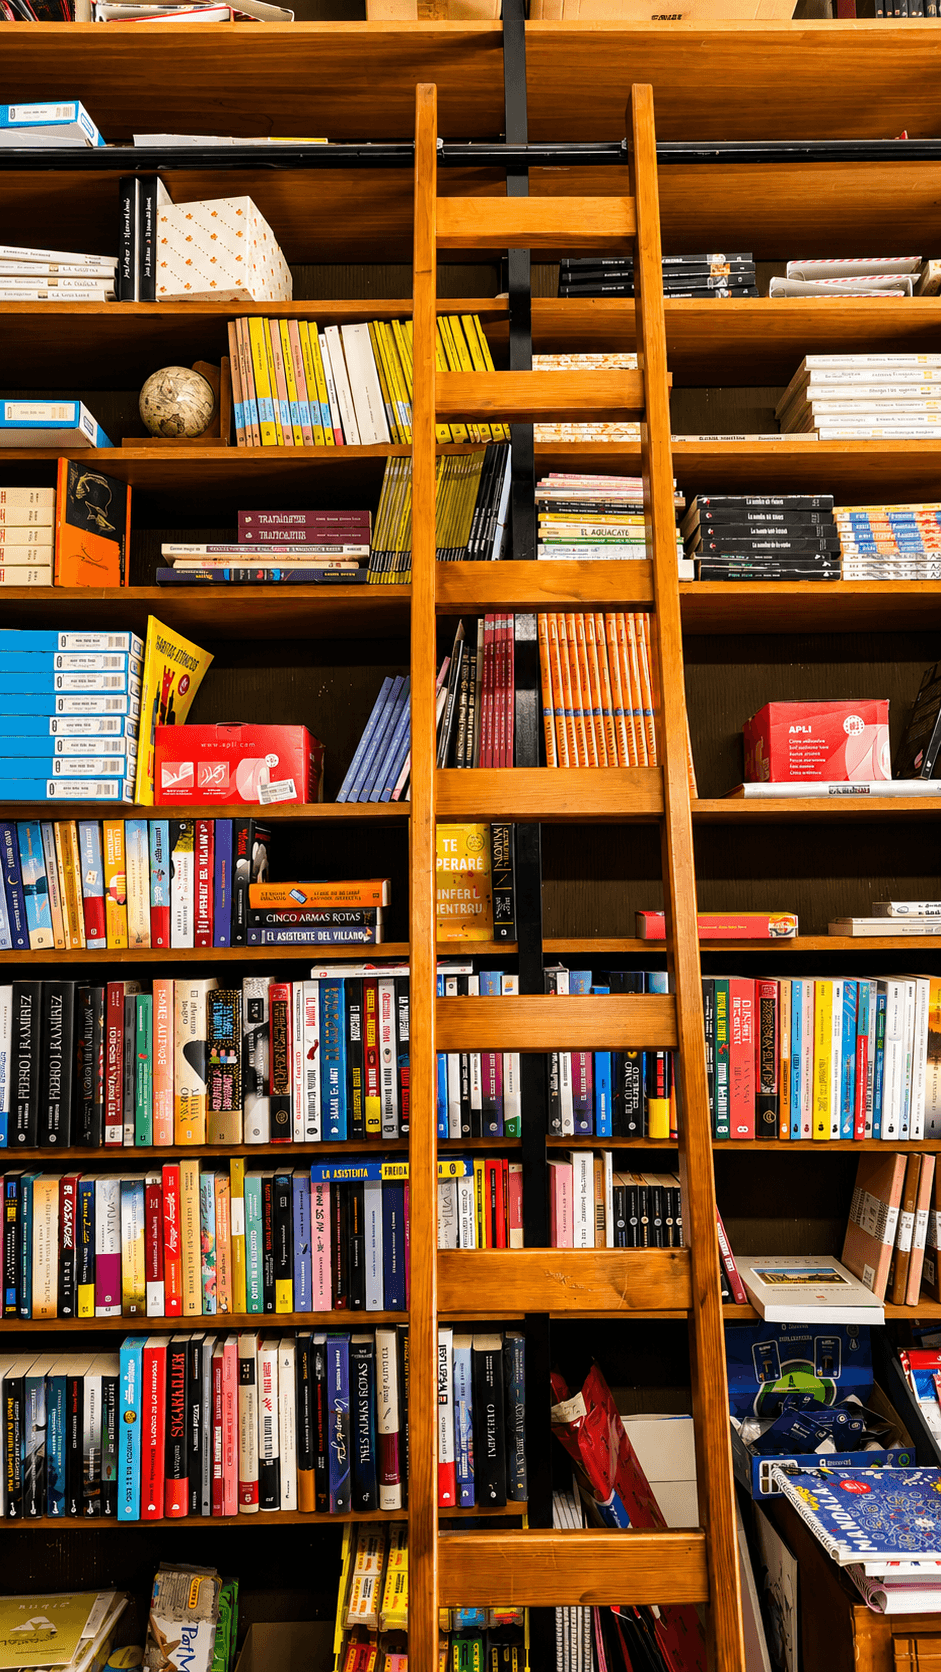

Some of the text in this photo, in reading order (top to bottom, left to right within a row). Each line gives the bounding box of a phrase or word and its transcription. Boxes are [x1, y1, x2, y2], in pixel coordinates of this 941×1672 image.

[788, 725, 812, 734] APLI
[265, 912, 361, 924] CINCO ARMAS ROTAS
[266, 931, 275, 942] EL
[317, 931, 331, 941] DEL
[321, 1169, 331, 1180] LA
